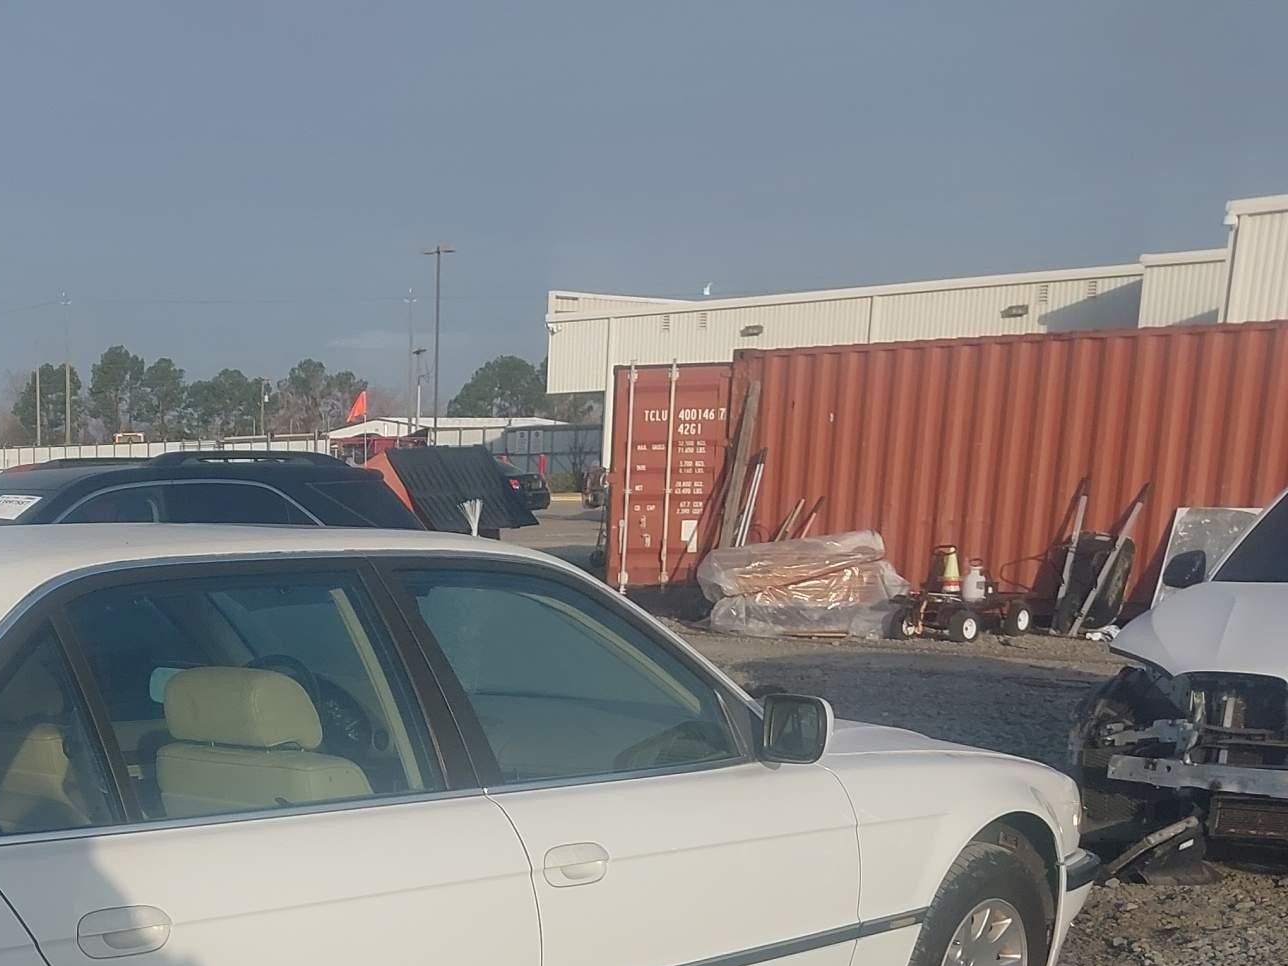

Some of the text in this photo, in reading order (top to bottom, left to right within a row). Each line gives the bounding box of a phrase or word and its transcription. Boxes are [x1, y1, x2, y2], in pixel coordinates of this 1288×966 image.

[644, 410, 668, 422] TCLU
[678, 408, 715, 421] 400146
[677, 423, 702, 435] 42G1
